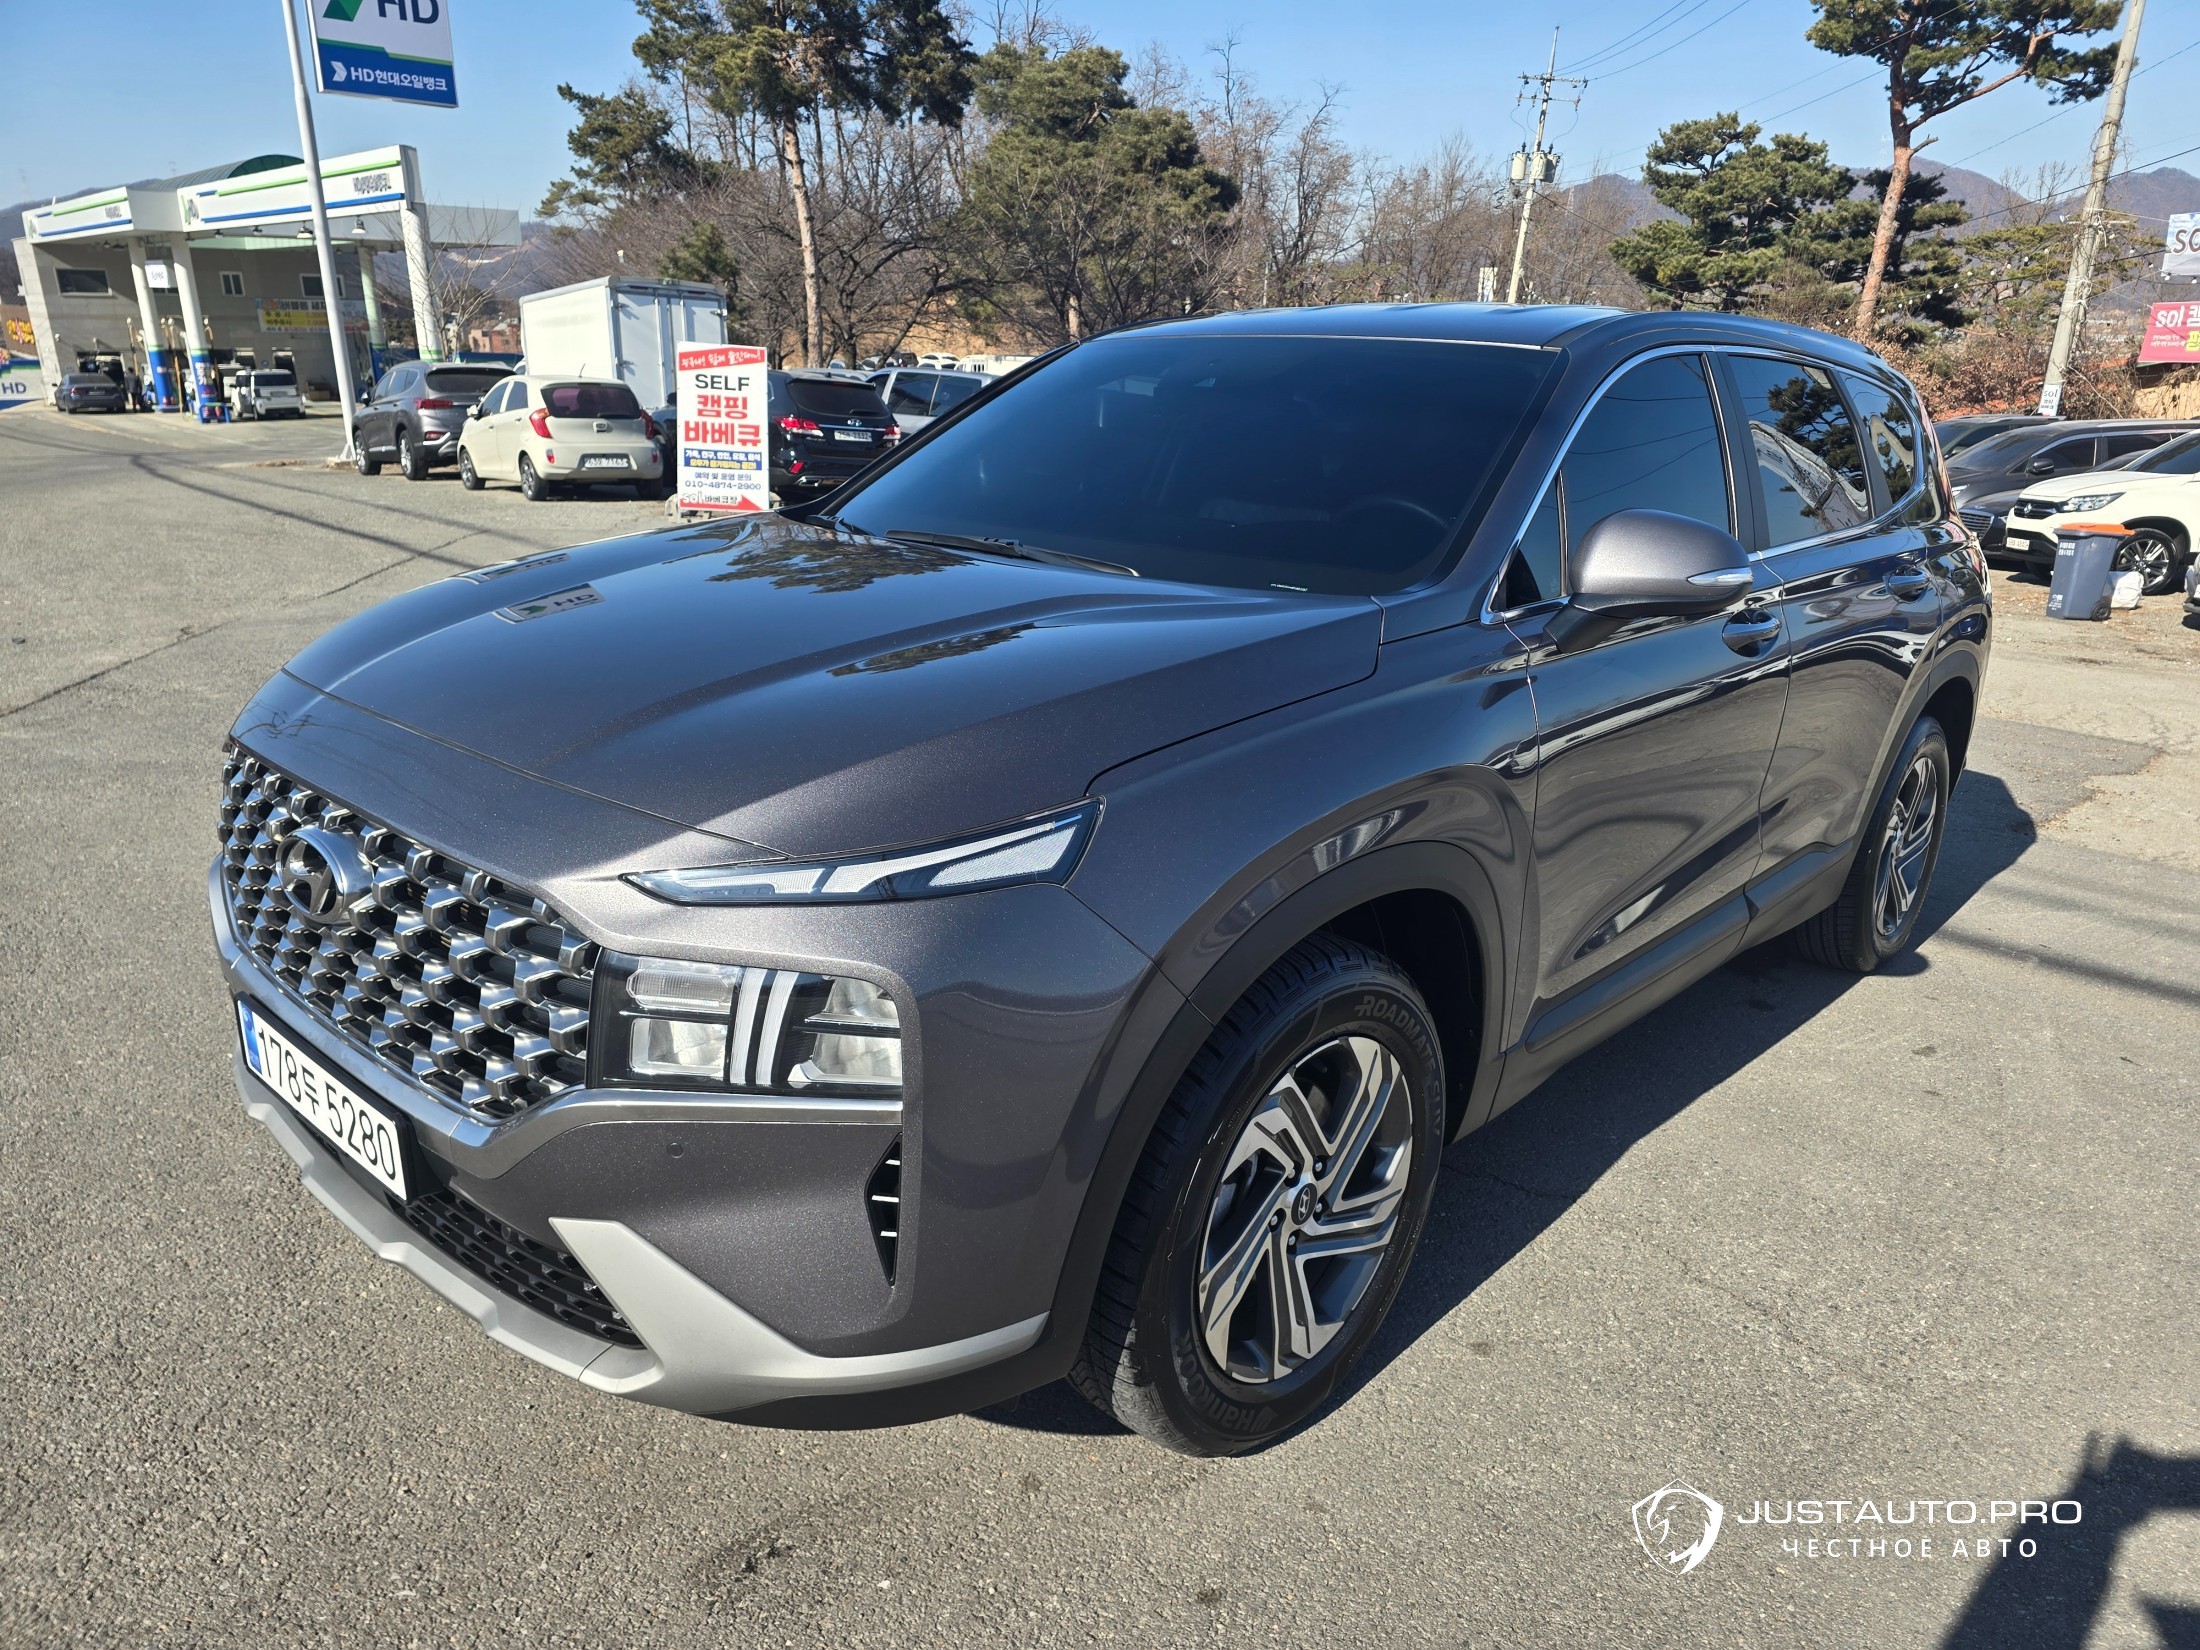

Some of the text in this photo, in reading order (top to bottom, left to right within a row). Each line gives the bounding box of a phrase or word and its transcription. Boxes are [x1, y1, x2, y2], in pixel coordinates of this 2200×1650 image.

[350, 66, 448, 91] HD현대오일뱅크
[2, 381, 27, 394] HD
[695, 373, 750, 391] SELF
[697, 394, 748, 420] 캠핑
[684, 420, 762, 447] 바베큐
[1355, 995, 1436, 1072] ROADMATE
